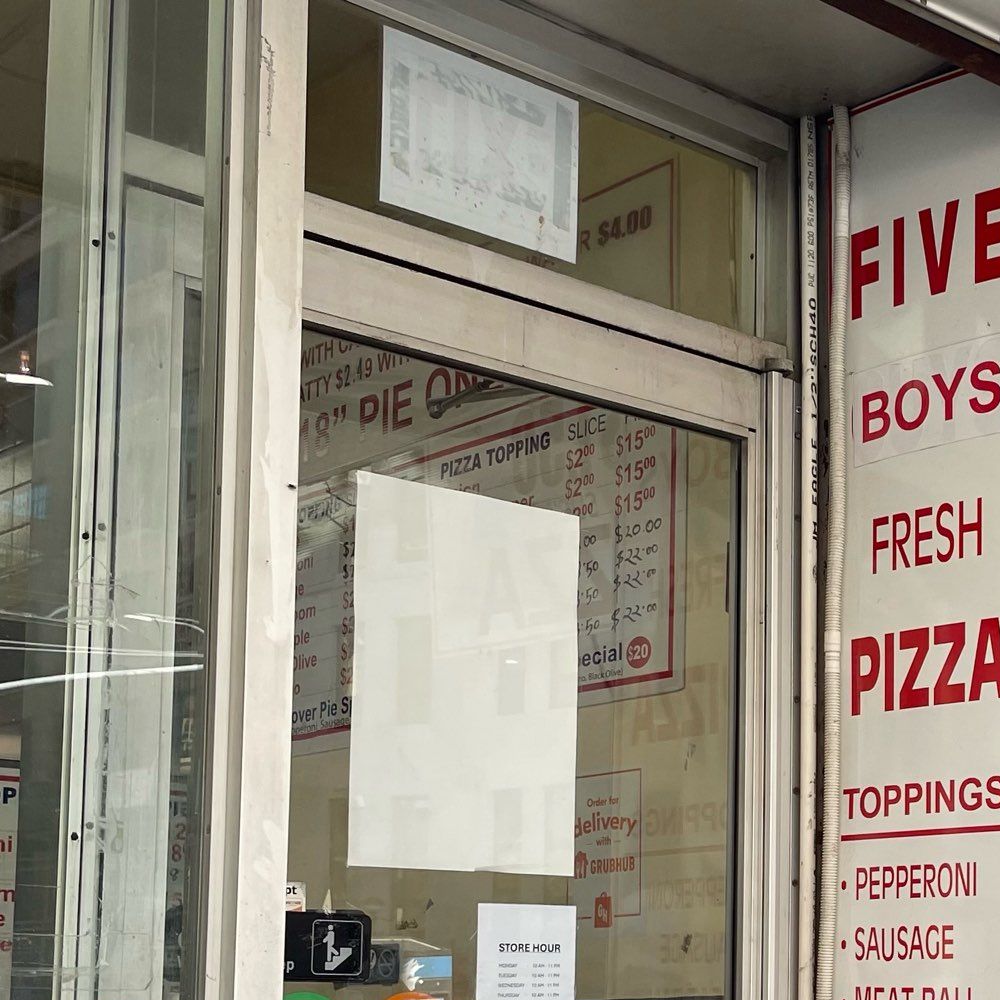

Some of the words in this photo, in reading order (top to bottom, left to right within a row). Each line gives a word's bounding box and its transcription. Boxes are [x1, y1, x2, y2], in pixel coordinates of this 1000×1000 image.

[598, 205, 652, 247] $4.00
[359, 379, 414, 443] PIE
[440, 453, 482, 480] PIZZA
[486, 431, 551, 467] TOPPING
[567, 414, 607, 441] SLICE
[872, 497, 983, 575] FRESH
[320, 700, 338, 719] Pie
[587, 798, 607, 808] Order
[575, 811, 637, 839] delivery
[596, 836, 612, 846] with
[590, 856, 635, 875] GRUBHUB
[855, 862, 978, 900] PEPPERONI
[499, 943, 530, 952] STORE
[532, 943, 561, 953] HOUR
[854, 924, 954, 962] SAUSAGE
